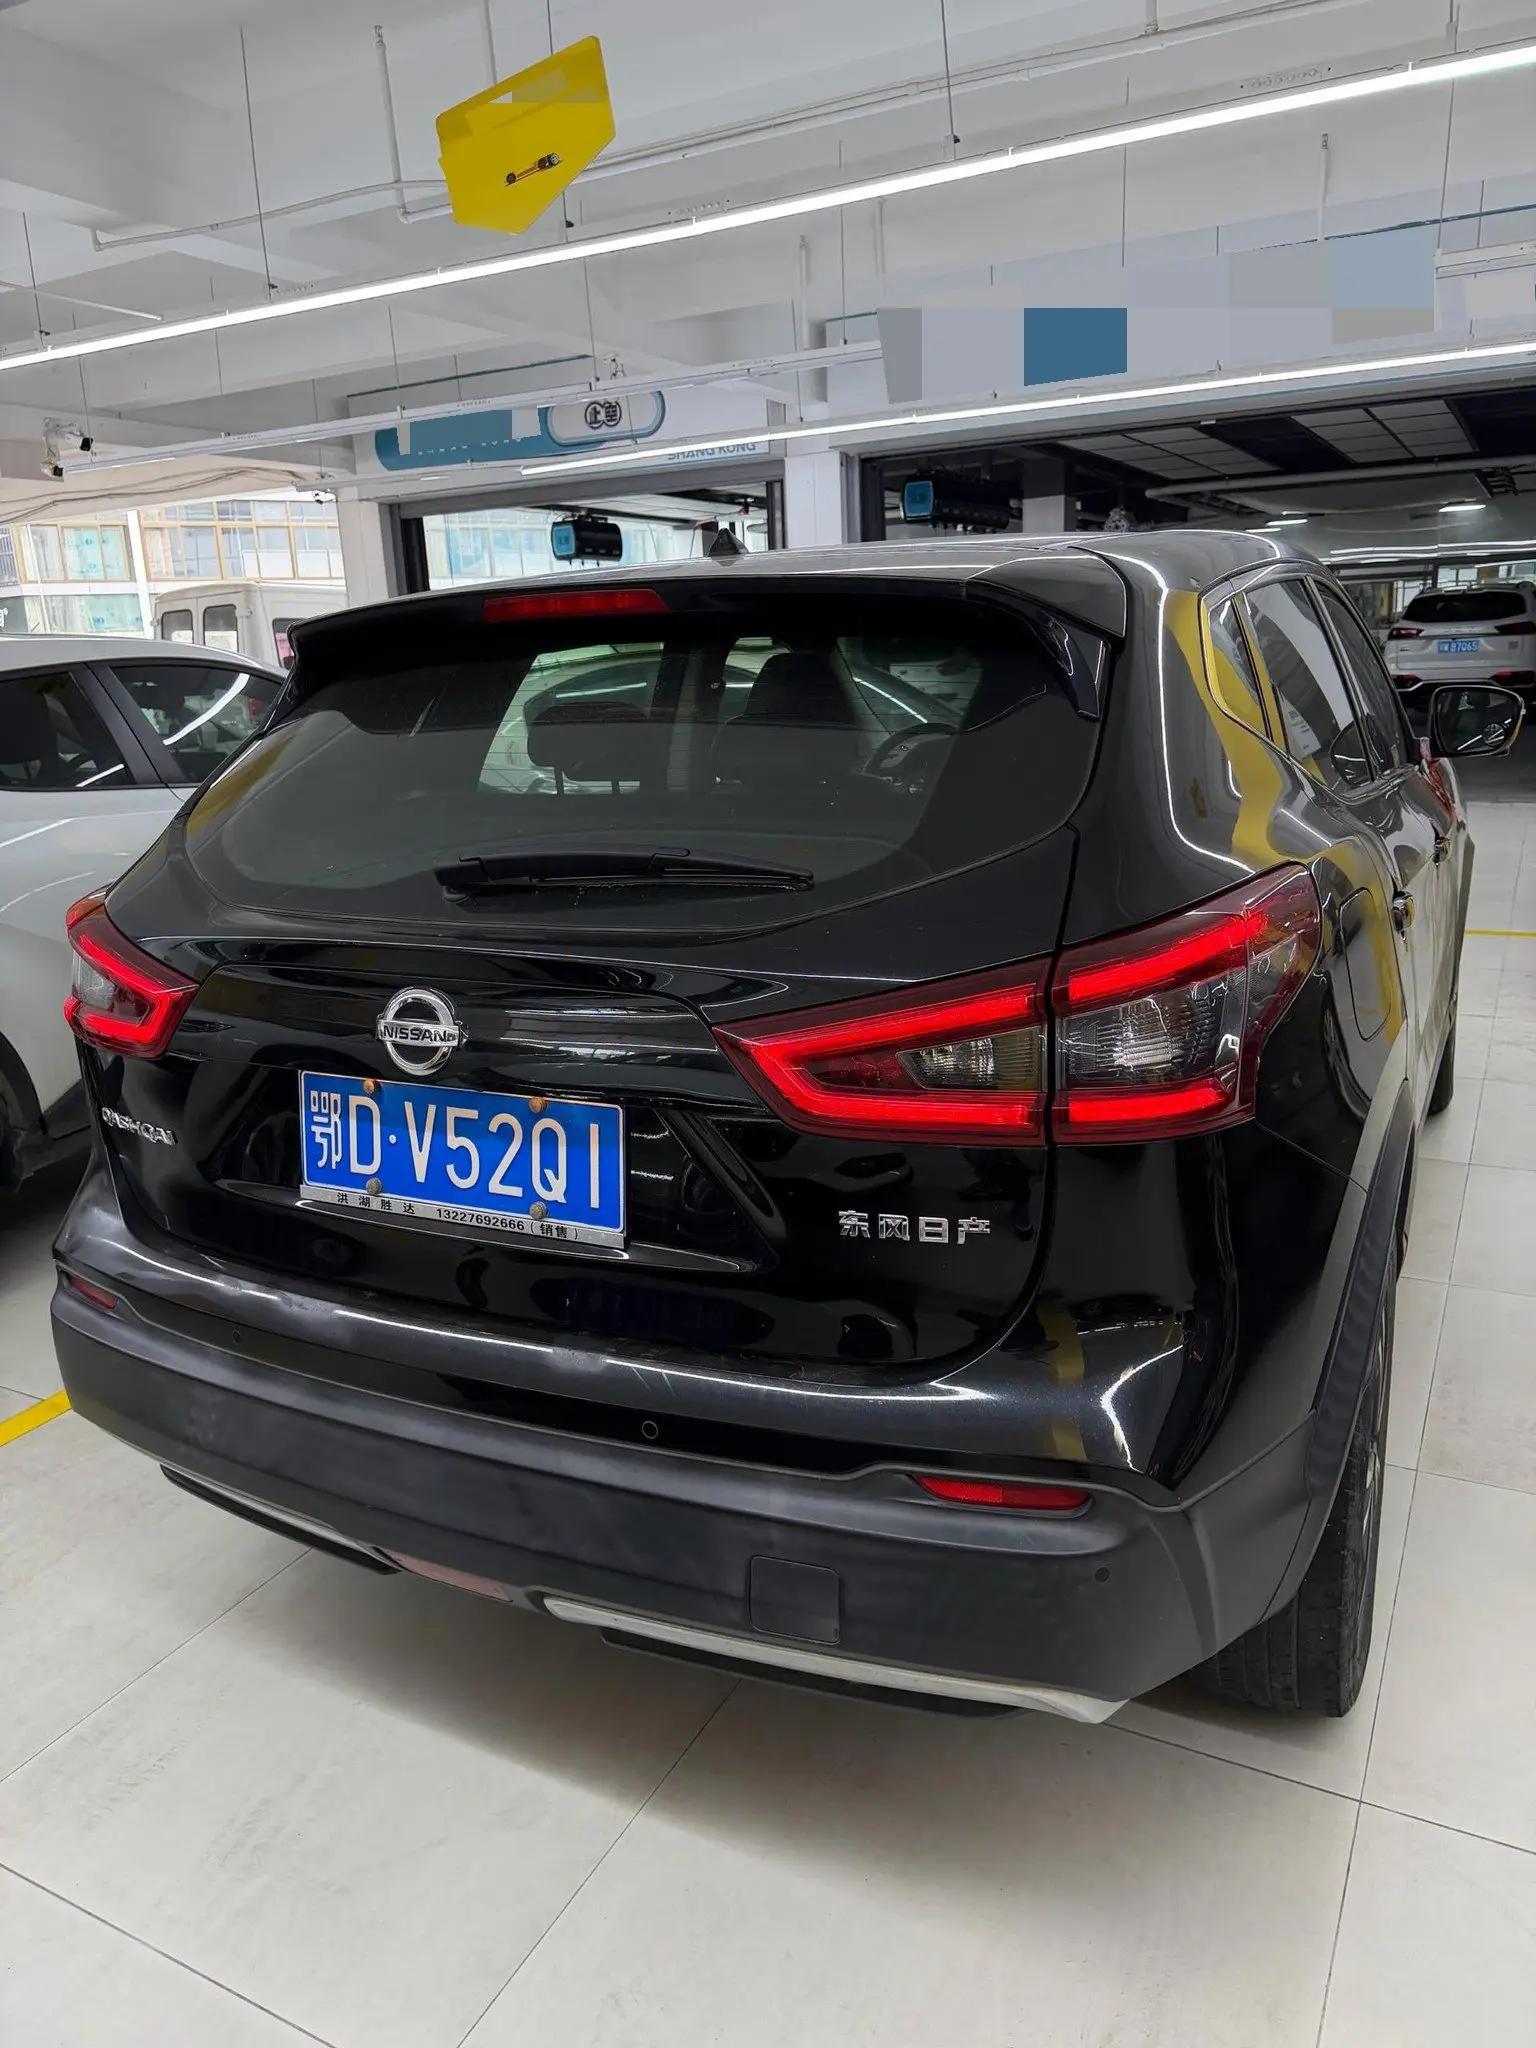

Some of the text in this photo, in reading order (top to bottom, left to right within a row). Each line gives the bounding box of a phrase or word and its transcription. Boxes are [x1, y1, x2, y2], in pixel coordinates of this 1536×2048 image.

[383, 1025, 448, 1042] NISSAN
[436, 1208, 525, 1231] 13227692666
[838, 1210, 990, 1244] 东风日产
